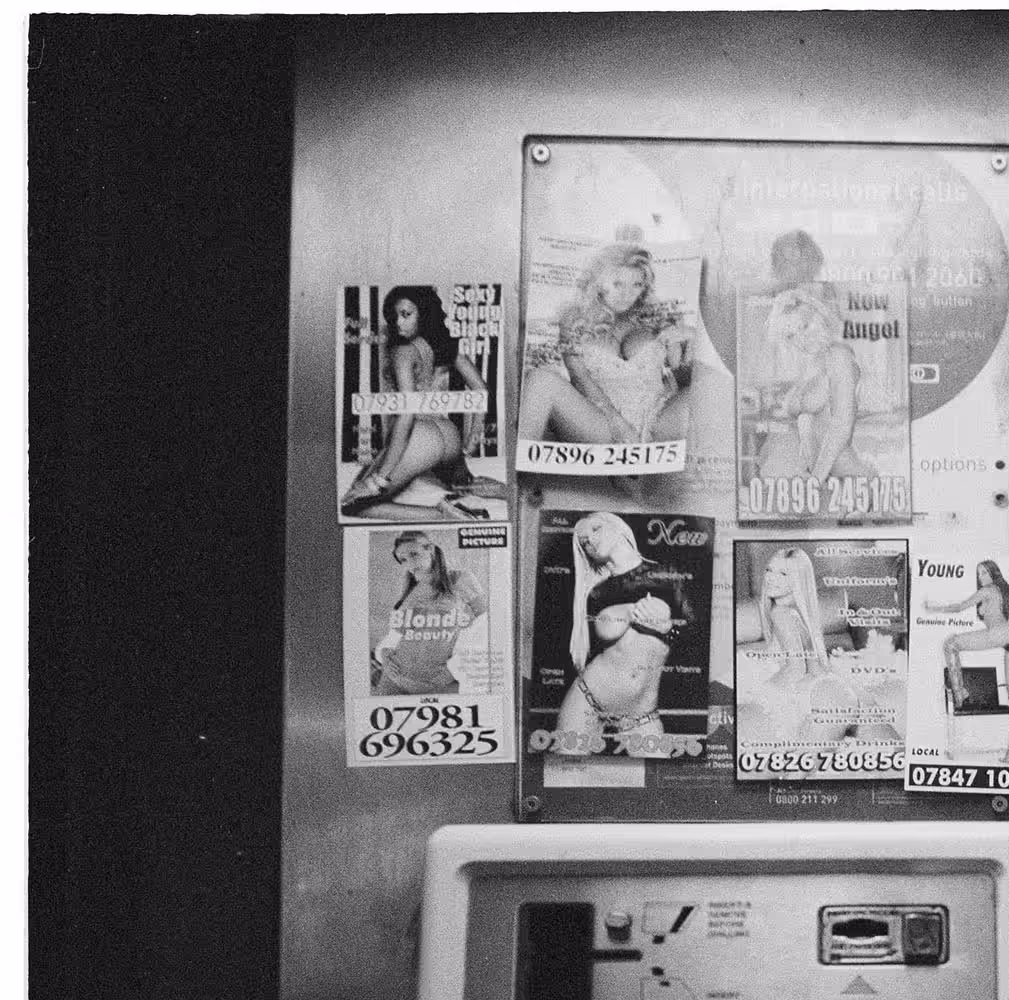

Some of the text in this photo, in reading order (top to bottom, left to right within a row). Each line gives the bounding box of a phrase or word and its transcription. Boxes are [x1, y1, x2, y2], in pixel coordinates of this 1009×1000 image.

[843, 320, 899, 341] Angel
[528, 443, 595, 466] 07896
[603, 443, 679, 466] 245175
[920, 457, 987, 474] options
[750, 475, 908, 514] 07896 245175
[459, 528, 506, 537] GENUINE
[461, 538, 505, 547] PICTURE
[917, 559, 965, 579] YOUNG
[390, 606, 471, 629] Blonde
[916, 617, 974, 628] Genuine Picture
[404, 629, 454, 642] Beauty
[369, 704, 483, 731] 07981
[359, 729, 499, 759] 696325
[740, 740, 851, 749] Complimentary
[911, 747, 940, 757] LOCAL
[738, 751, 906, 773] 07826 780856
[912, 766, 978, 787] 07847
[775, 794, 838, 804] 0800 211 299
